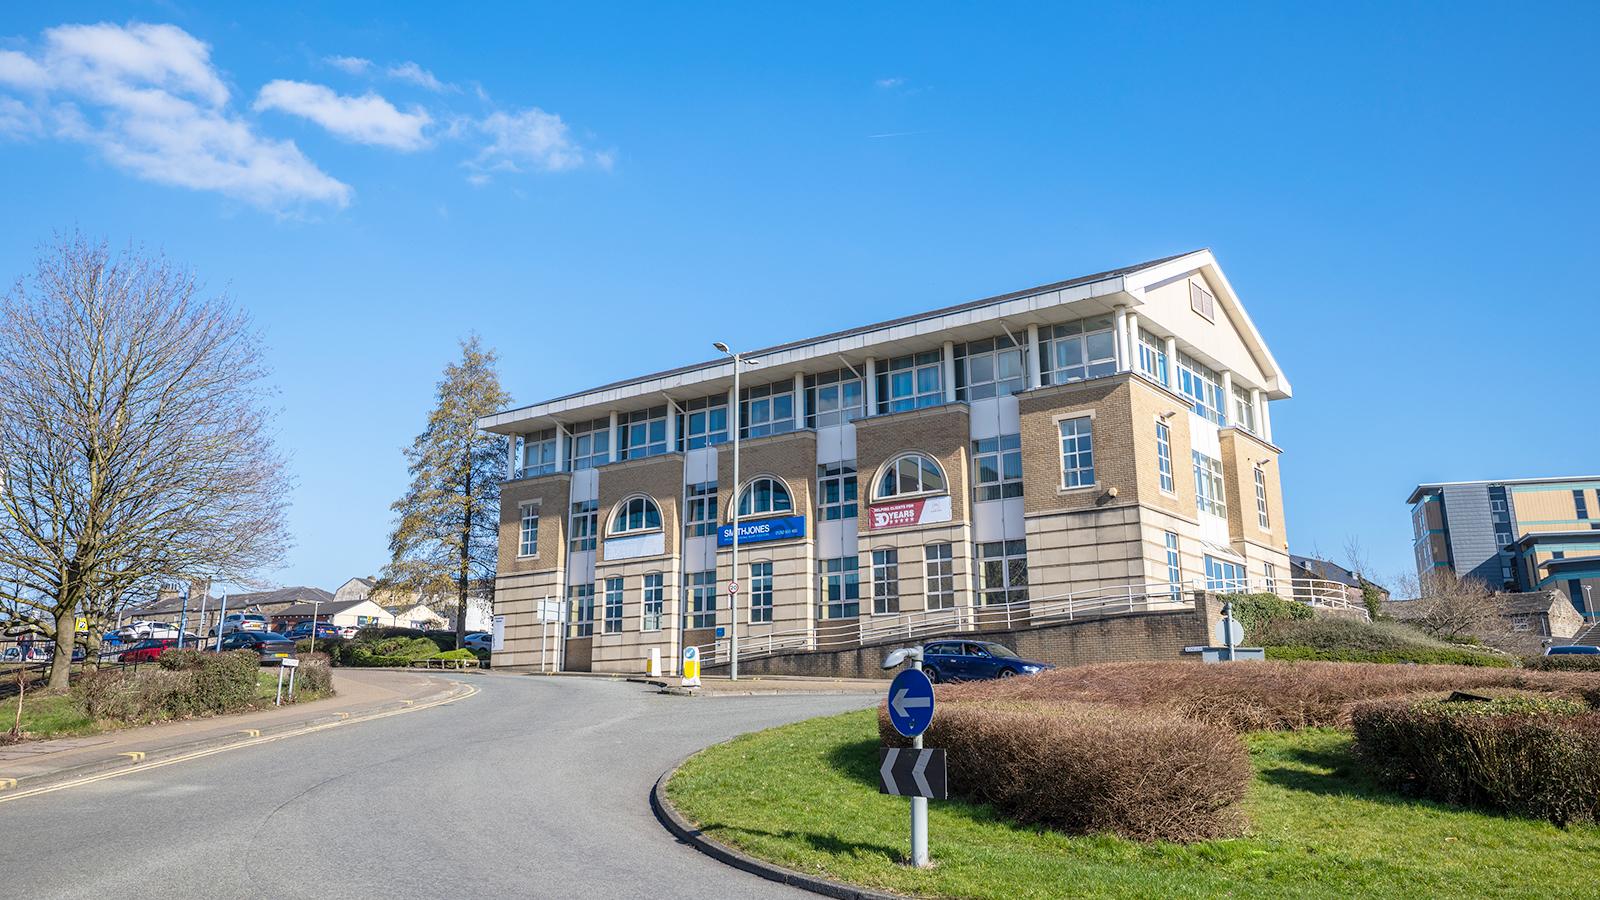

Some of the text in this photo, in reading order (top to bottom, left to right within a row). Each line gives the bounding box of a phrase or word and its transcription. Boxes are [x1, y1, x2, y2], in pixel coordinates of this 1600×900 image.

[874, 510, 914, 527] 30 YEARS
[724, 524, 770, 538] SMTHJONES
